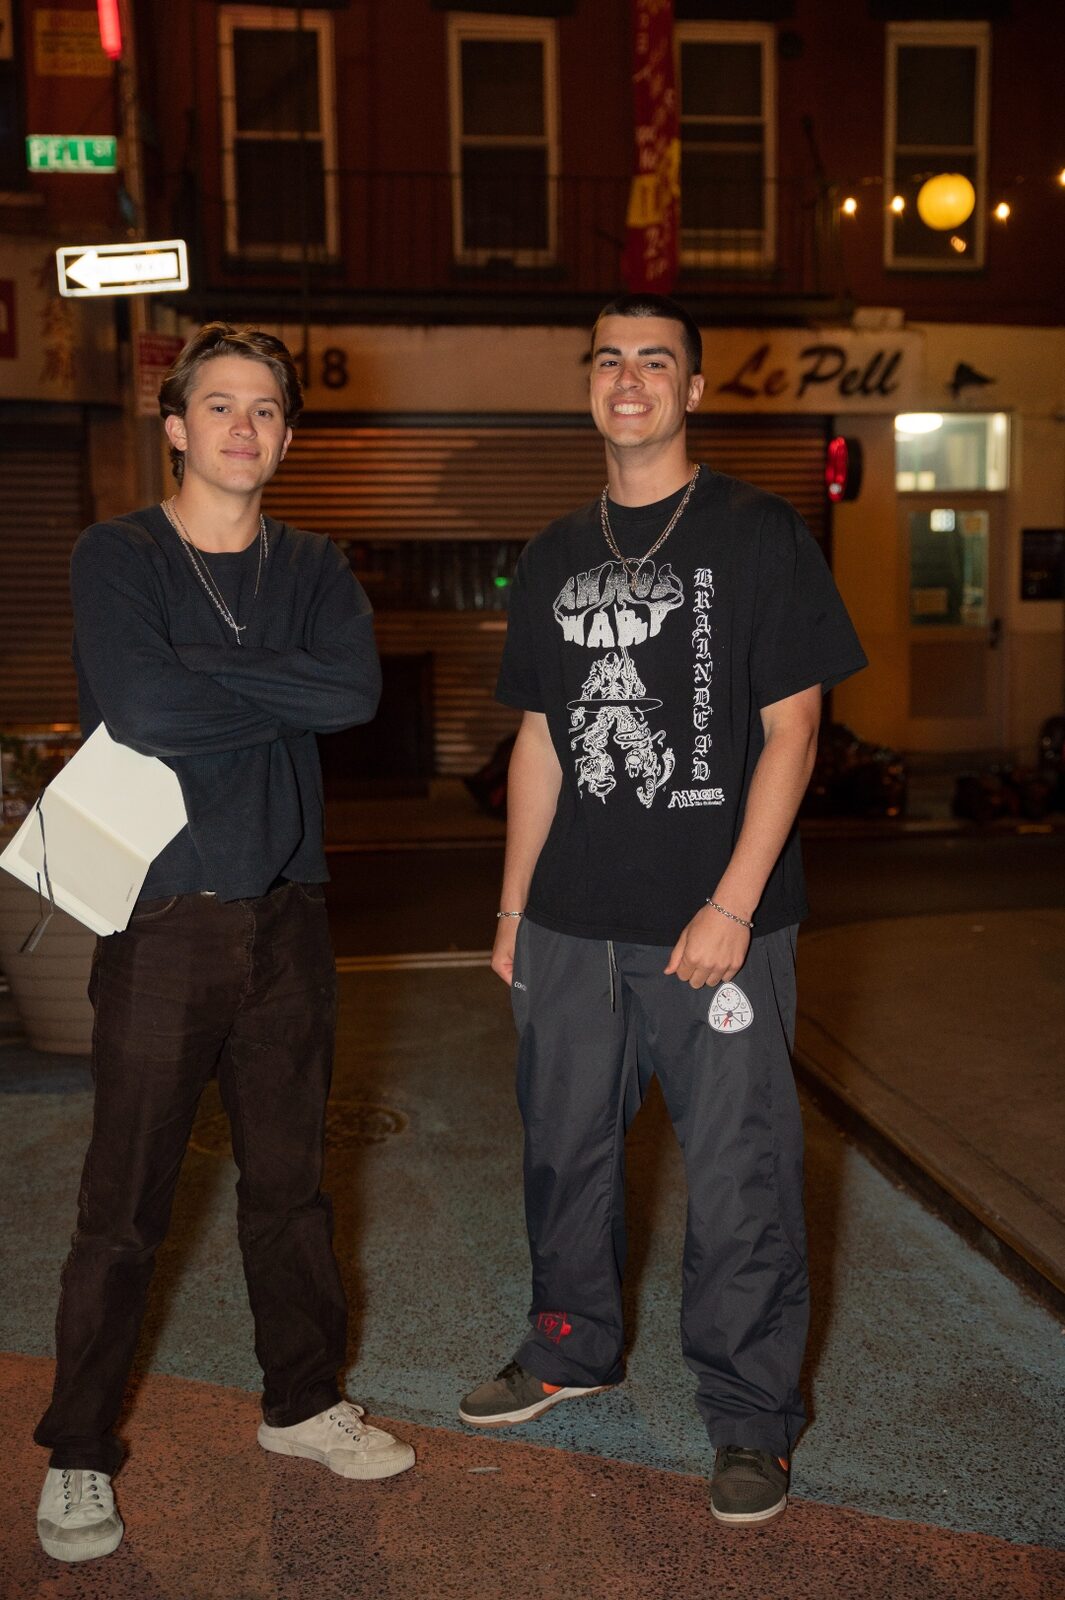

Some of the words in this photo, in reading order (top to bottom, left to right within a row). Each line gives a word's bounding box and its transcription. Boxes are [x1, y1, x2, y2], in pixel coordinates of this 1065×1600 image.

[30, 138, 94, 167] PELL
[718, 345, 788, 398] Le
[797, 345, 903, 398] Pell
